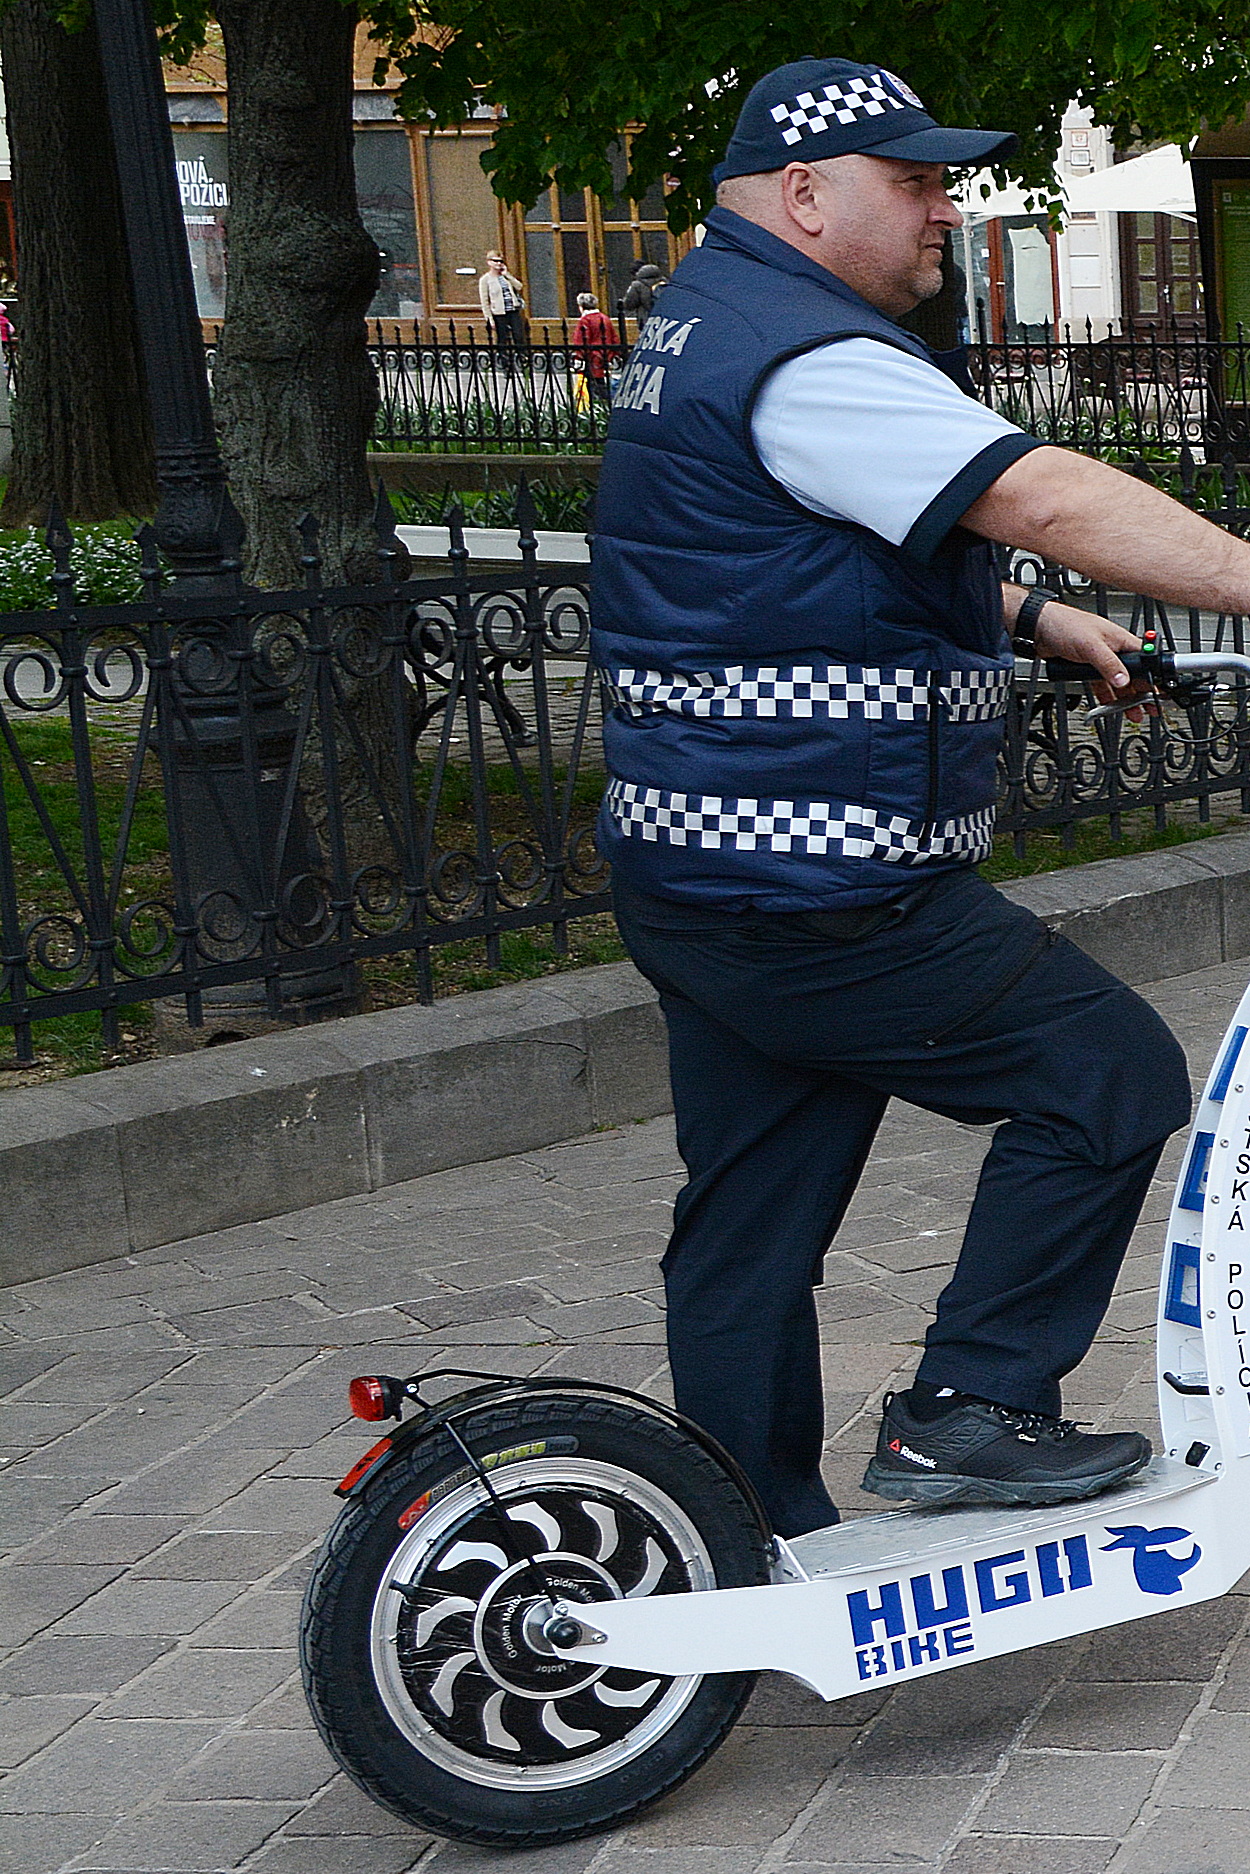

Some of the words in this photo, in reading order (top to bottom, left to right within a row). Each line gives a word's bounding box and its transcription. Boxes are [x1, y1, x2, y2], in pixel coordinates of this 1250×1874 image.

[176, 156, 208, 183] OVÁ
[180, 178, 230, 206] POZÍCI
[634, 316, 702, 356] TSKÁ
[612, 351, 665, 415] LÍCIA
[900, 1445, 938, 1469] Reebok
[846, 1534, 1093, 1647] HUGO
[502, 1624, 518, 1658] Golden
[855, 1622, 975, 1681] BIKE
[535, 1661, 568, 1674] Motor
